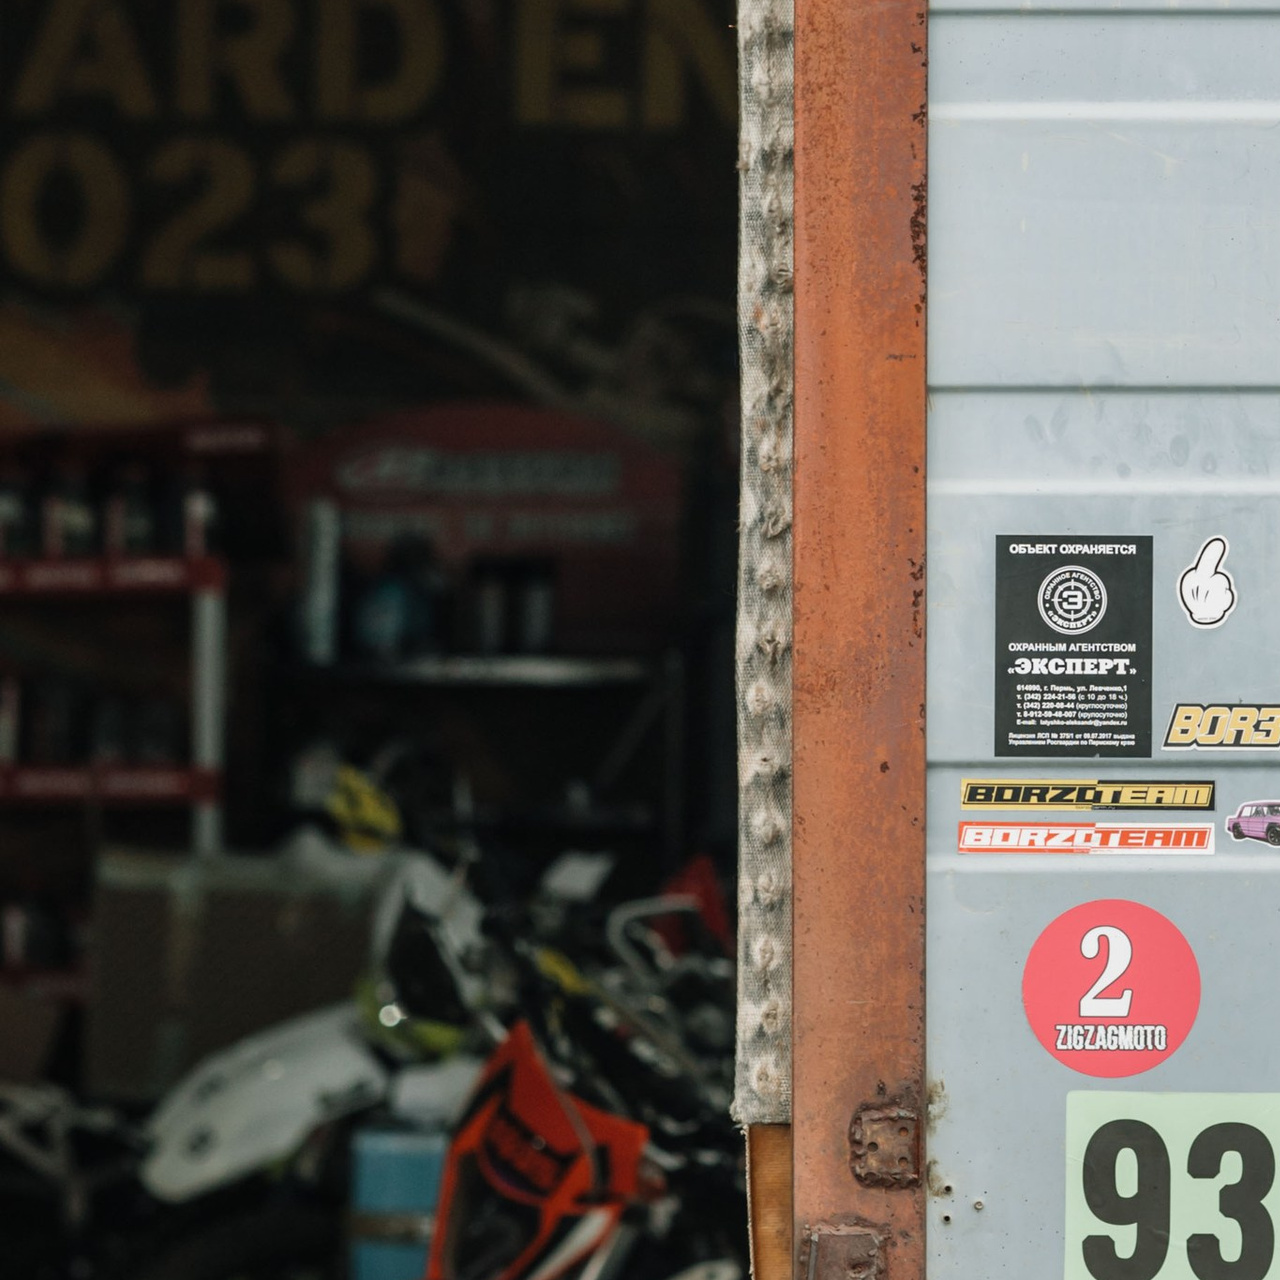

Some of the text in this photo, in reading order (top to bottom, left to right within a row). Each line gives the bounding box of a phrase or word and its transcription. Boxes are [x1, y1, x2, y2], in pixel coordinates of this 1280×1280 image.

[1009, 544, 1136, 555] ОБЪЕКТ ОХРАНЯЕТСЯ
[1044, 572, 1101, 600] ОХРАННОЕ АГЕНТСТВО
[1008, 643, 1136, 652] ОХРАННЫМ АГЕНТСТВОМ
[1007, 658, 1137, 675] «ЭКСПЕРТ»
[1077, 924, 1133, 1017] 2
[1054, 1023, 1168, 1051] ZIGZAGMOTO
